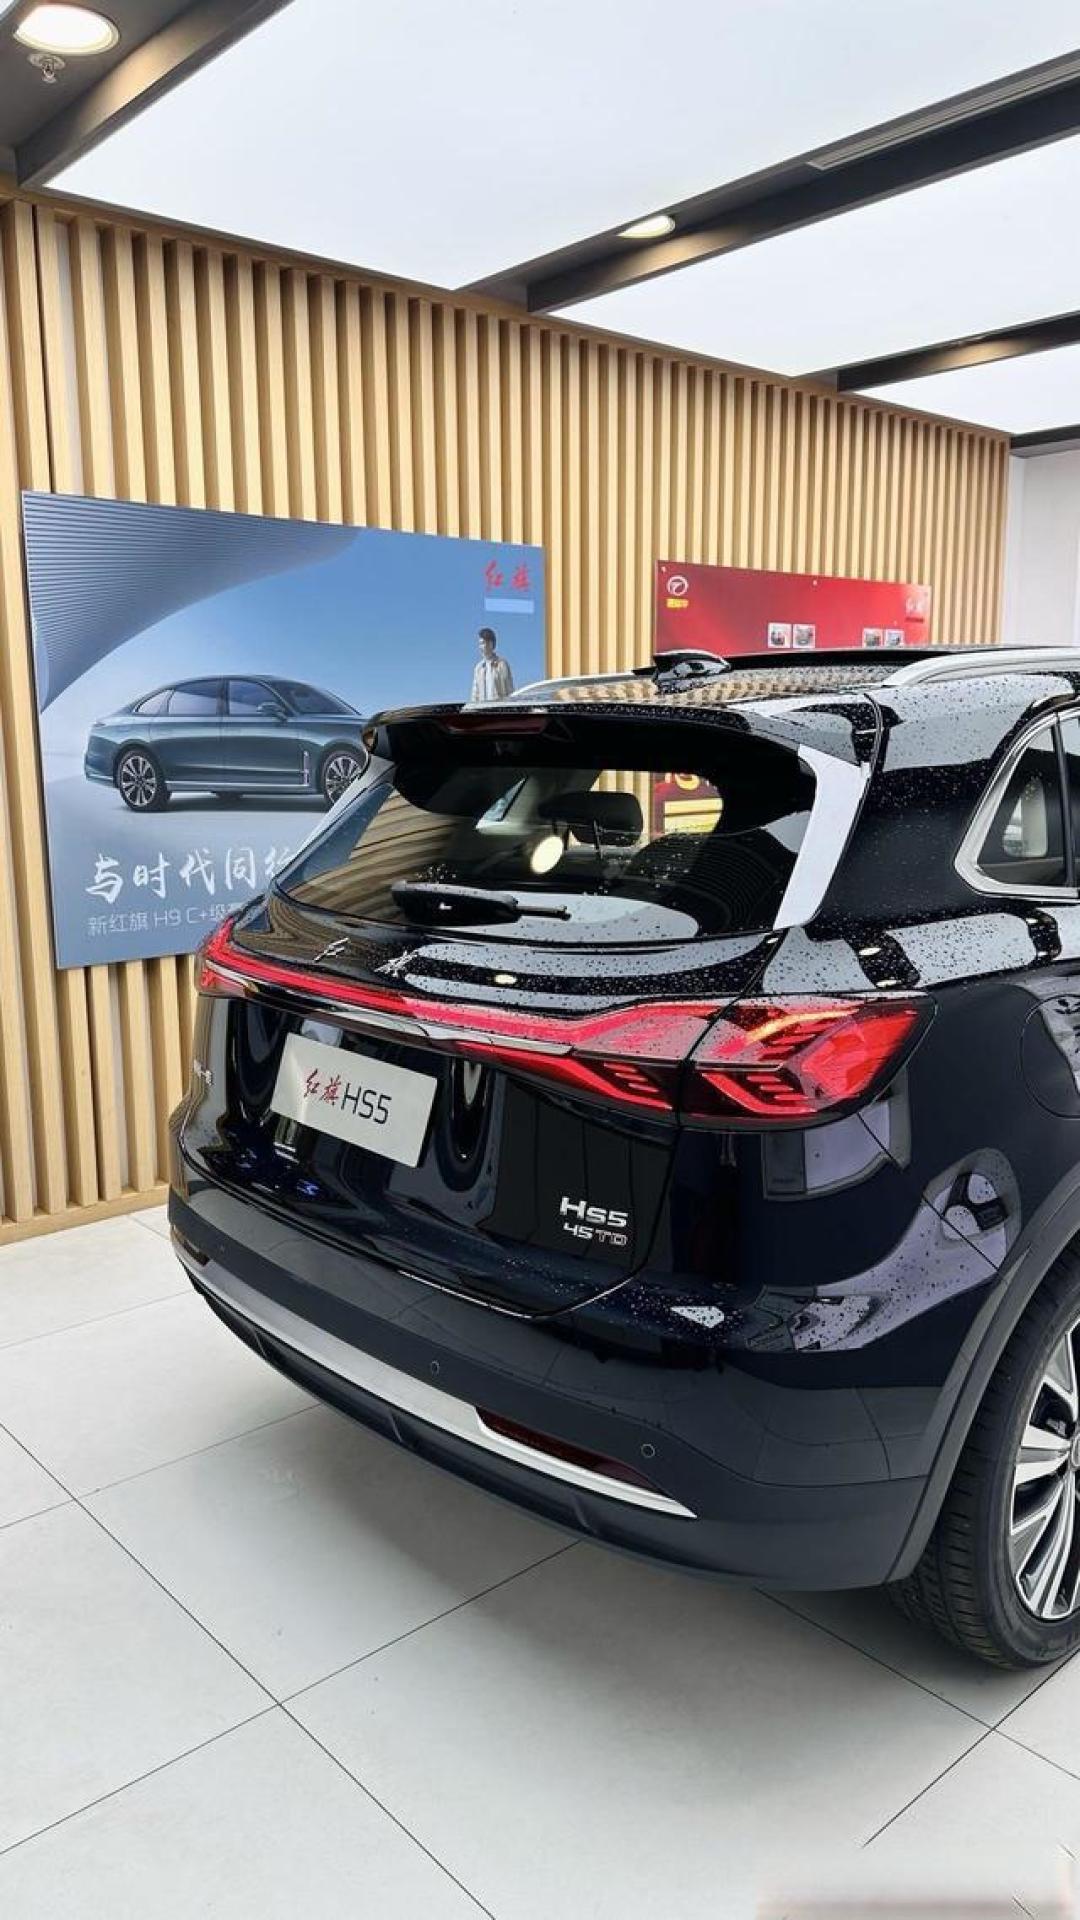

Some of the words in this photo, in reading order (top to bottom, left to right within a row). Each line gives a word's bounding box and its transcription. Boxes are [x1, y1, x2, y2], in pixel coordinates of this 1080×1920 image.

[87, 912, 148, 936] 新红旗
[154, 908, 181, 928] H9
[560, 1196, 629, 1228] HS5
[563, 1222, 628, 1246] 45TD
